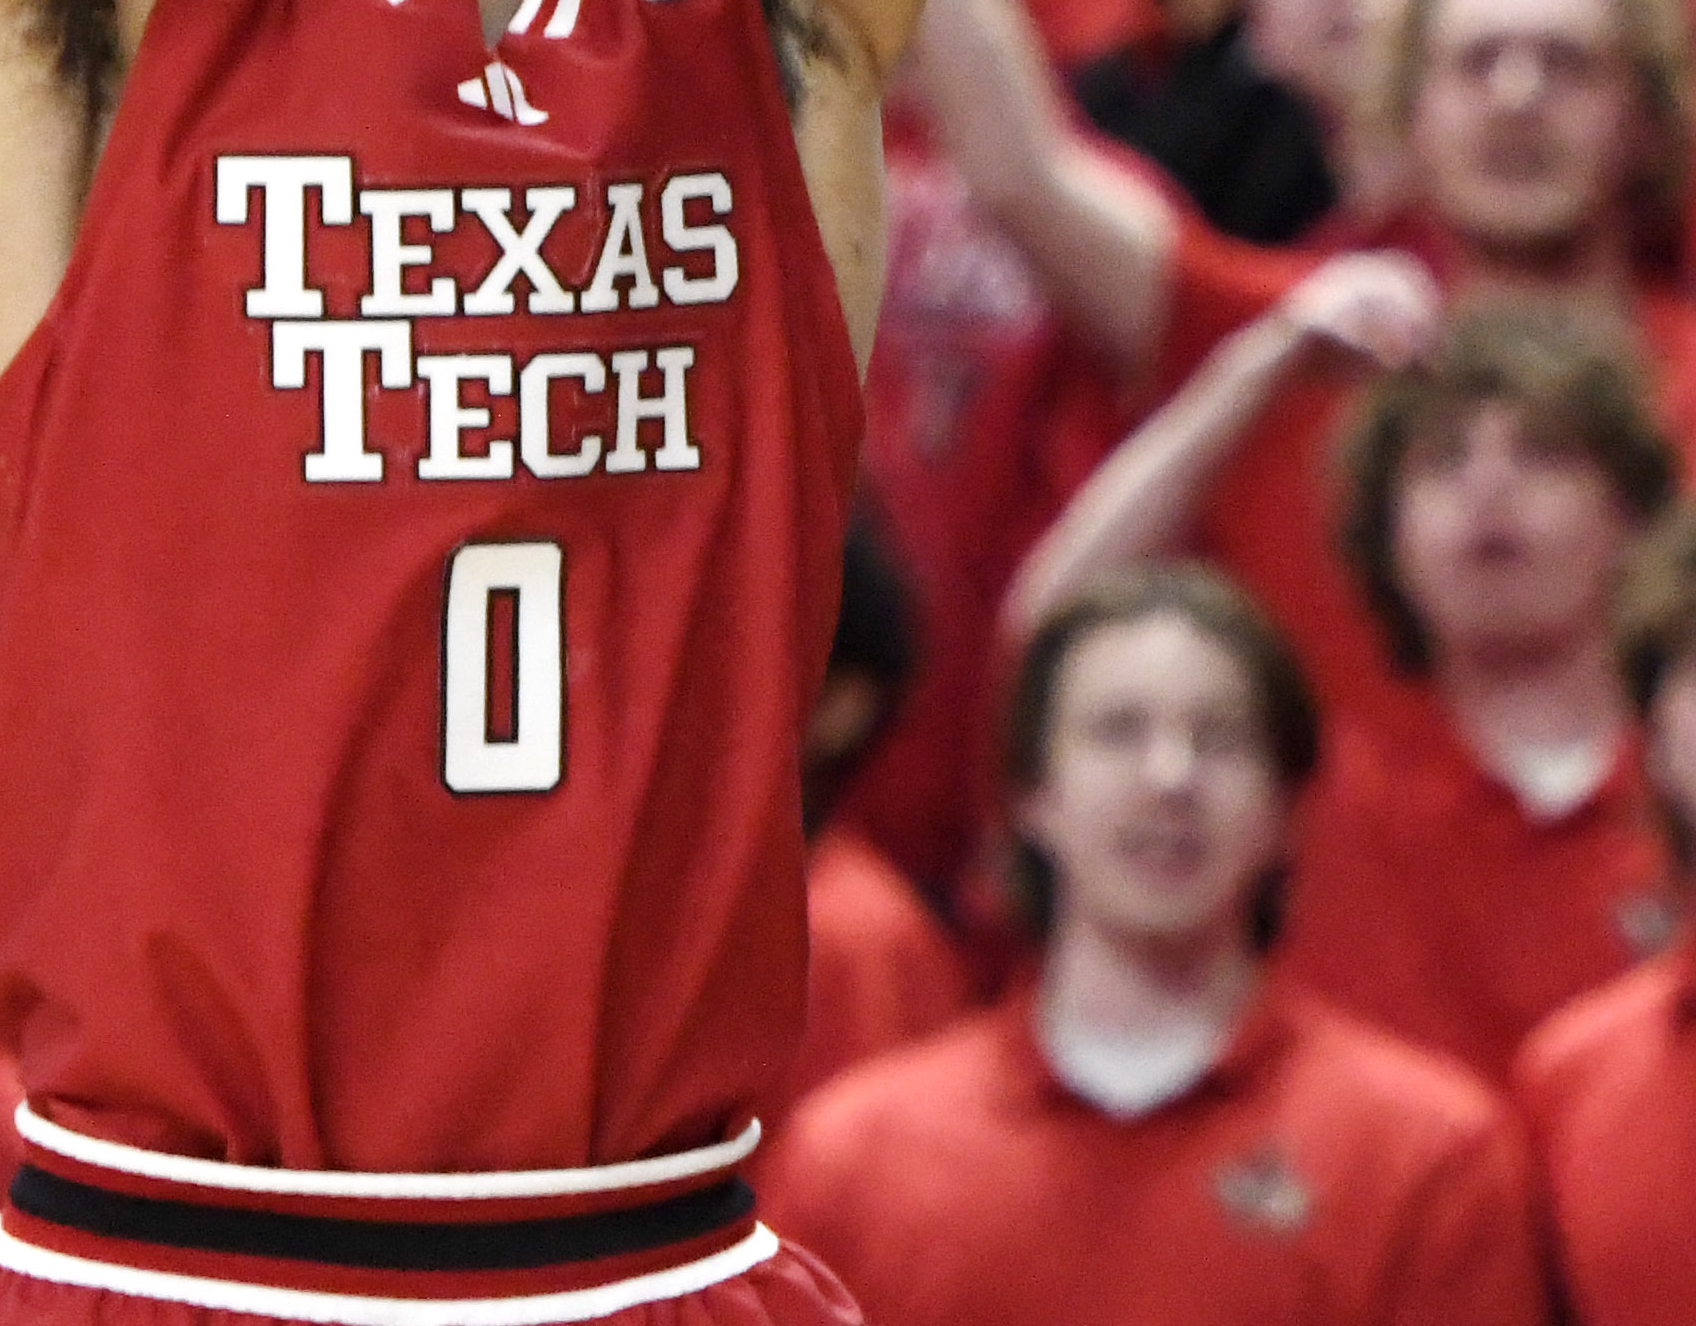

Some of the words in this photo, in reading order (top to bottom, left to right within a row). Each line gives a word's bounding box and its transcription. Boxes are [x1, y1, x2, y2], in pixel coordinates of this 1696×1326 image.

[214, 153, 740, 318] TEXAS
[271, 318, 703, 483] TECH
[441, 538, 565, 795] 0
